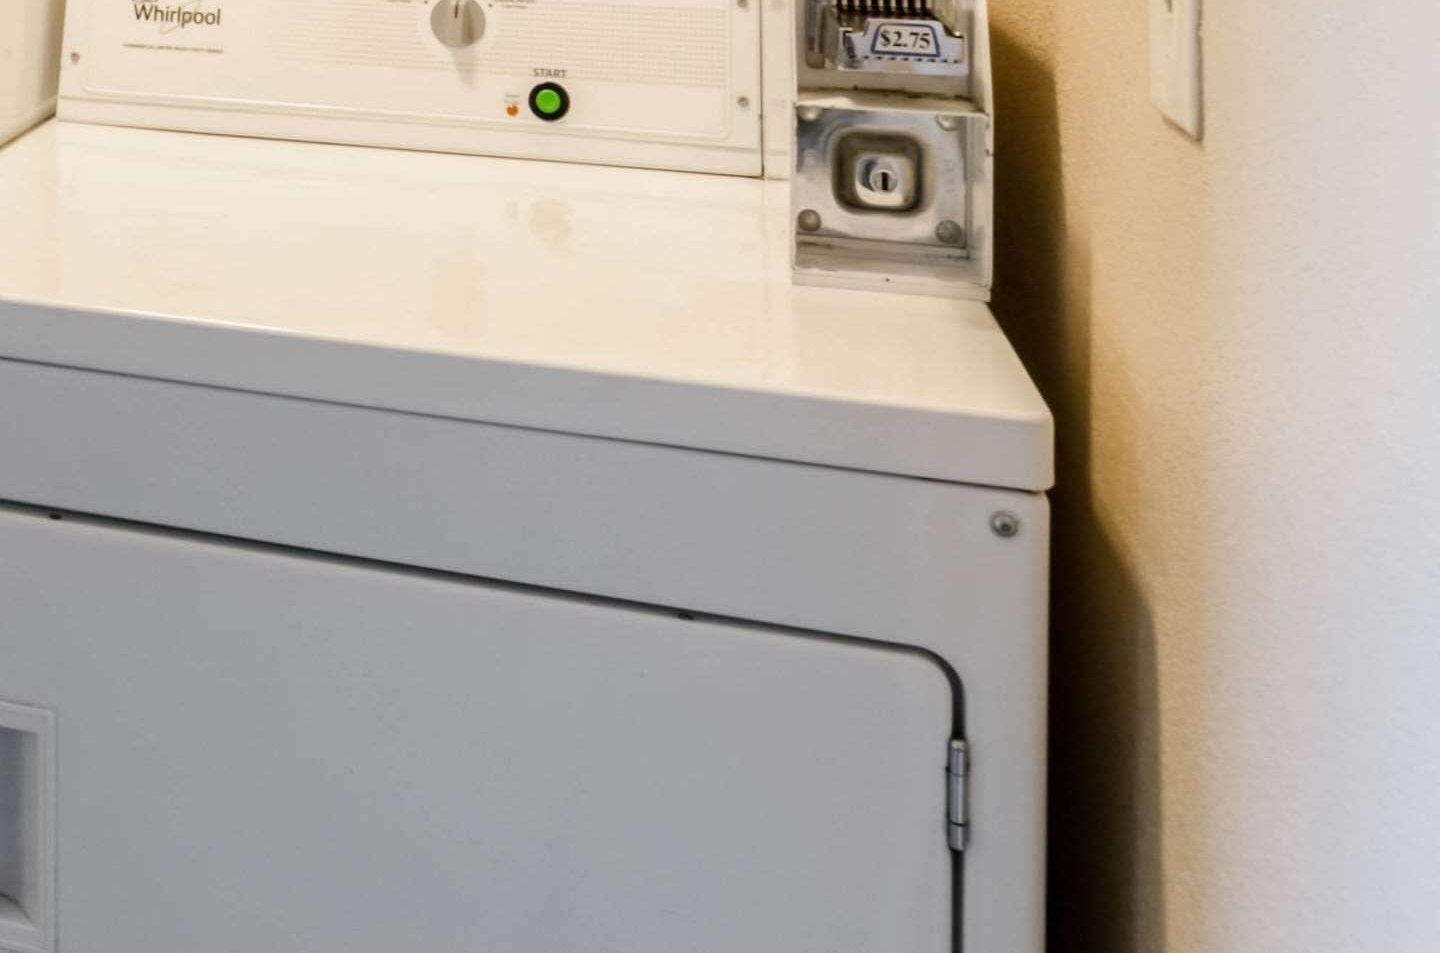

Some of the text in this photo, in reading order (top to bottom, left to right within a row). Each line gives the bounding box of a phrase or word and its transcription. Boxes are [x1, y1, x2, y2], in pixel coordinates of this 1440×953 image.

[133, 3, 222, 28] Whirlpool
[879, 30, 931, 49] $2.75
[532, 68, 568, 78] START
